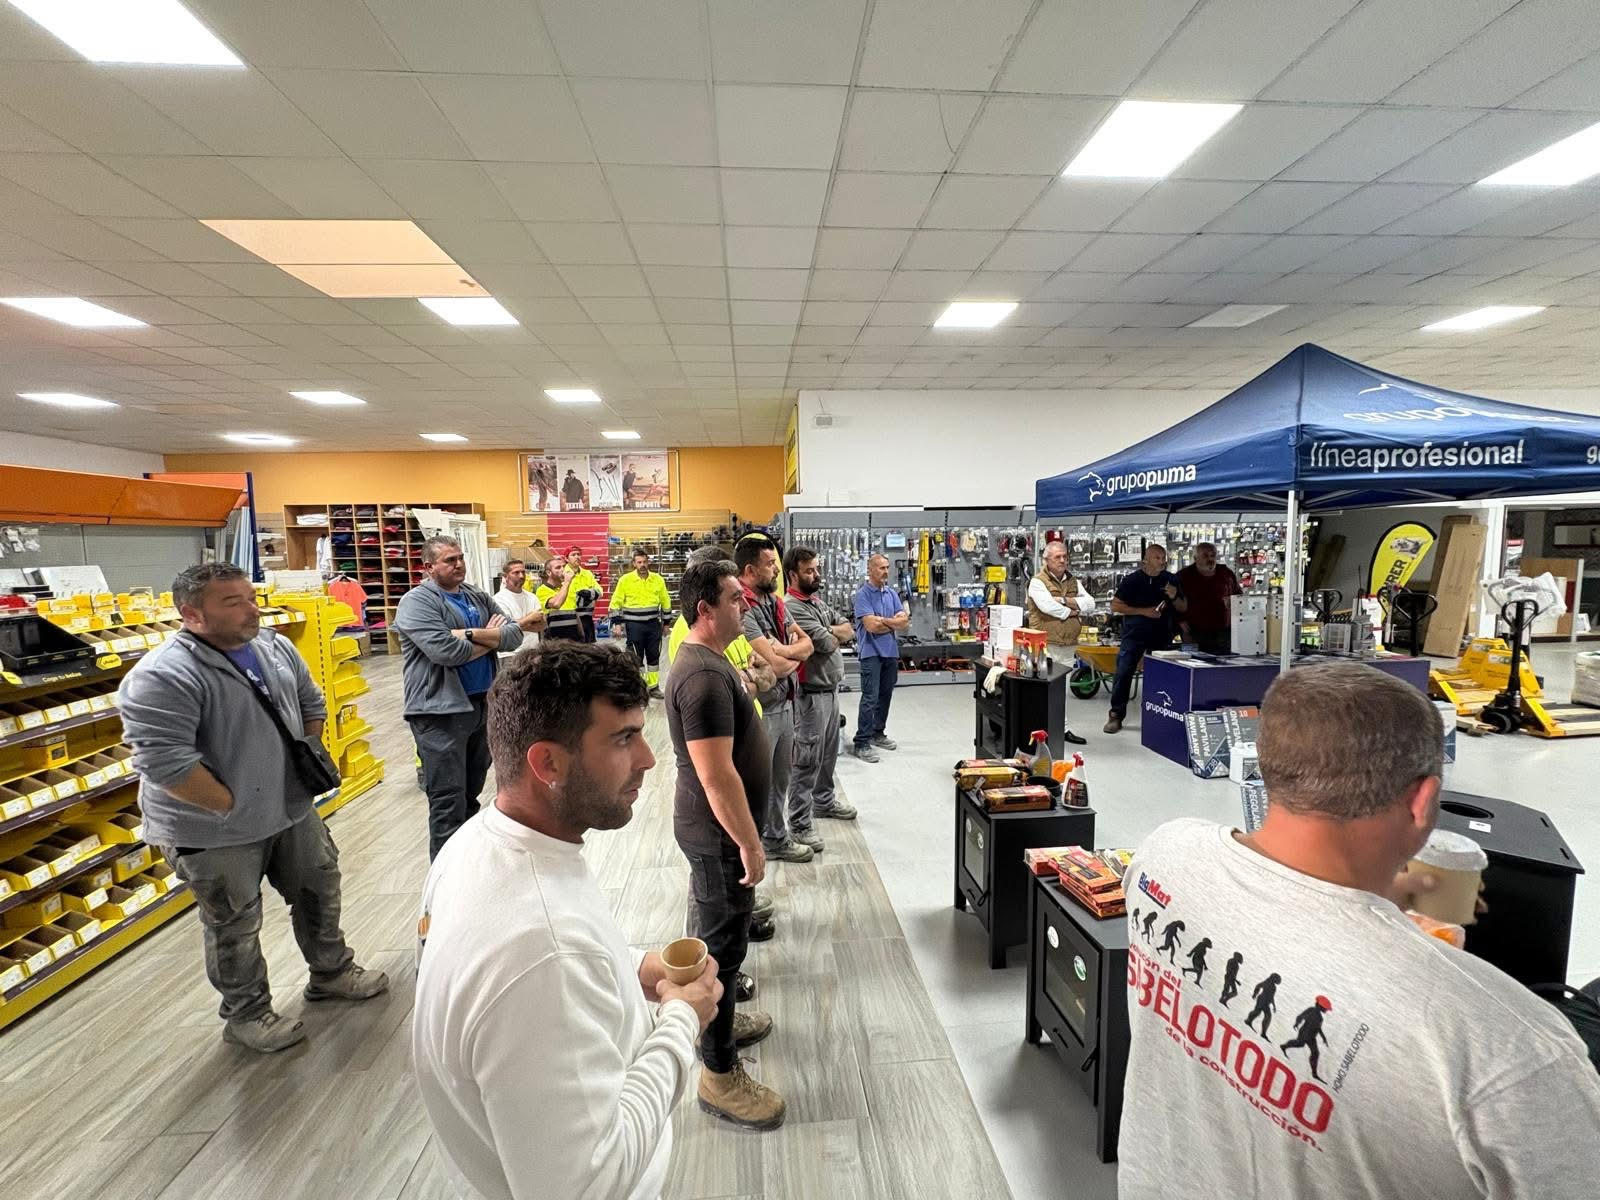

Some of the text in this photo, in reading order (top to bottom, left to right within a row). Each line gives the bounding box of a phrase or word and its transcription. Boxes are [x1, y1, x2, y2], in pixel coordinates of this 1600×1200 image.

[1106, 464, 1197, 497] grupopuma
[1145, 701, 1184, 722] grupopuma
[1198, 716, 1211, 758] PAVILAND
[1138, 872, 1171, 907] BigMat
[1163, 969, 1182, 989] del
[1165, 1026, 1181, 1042] de
